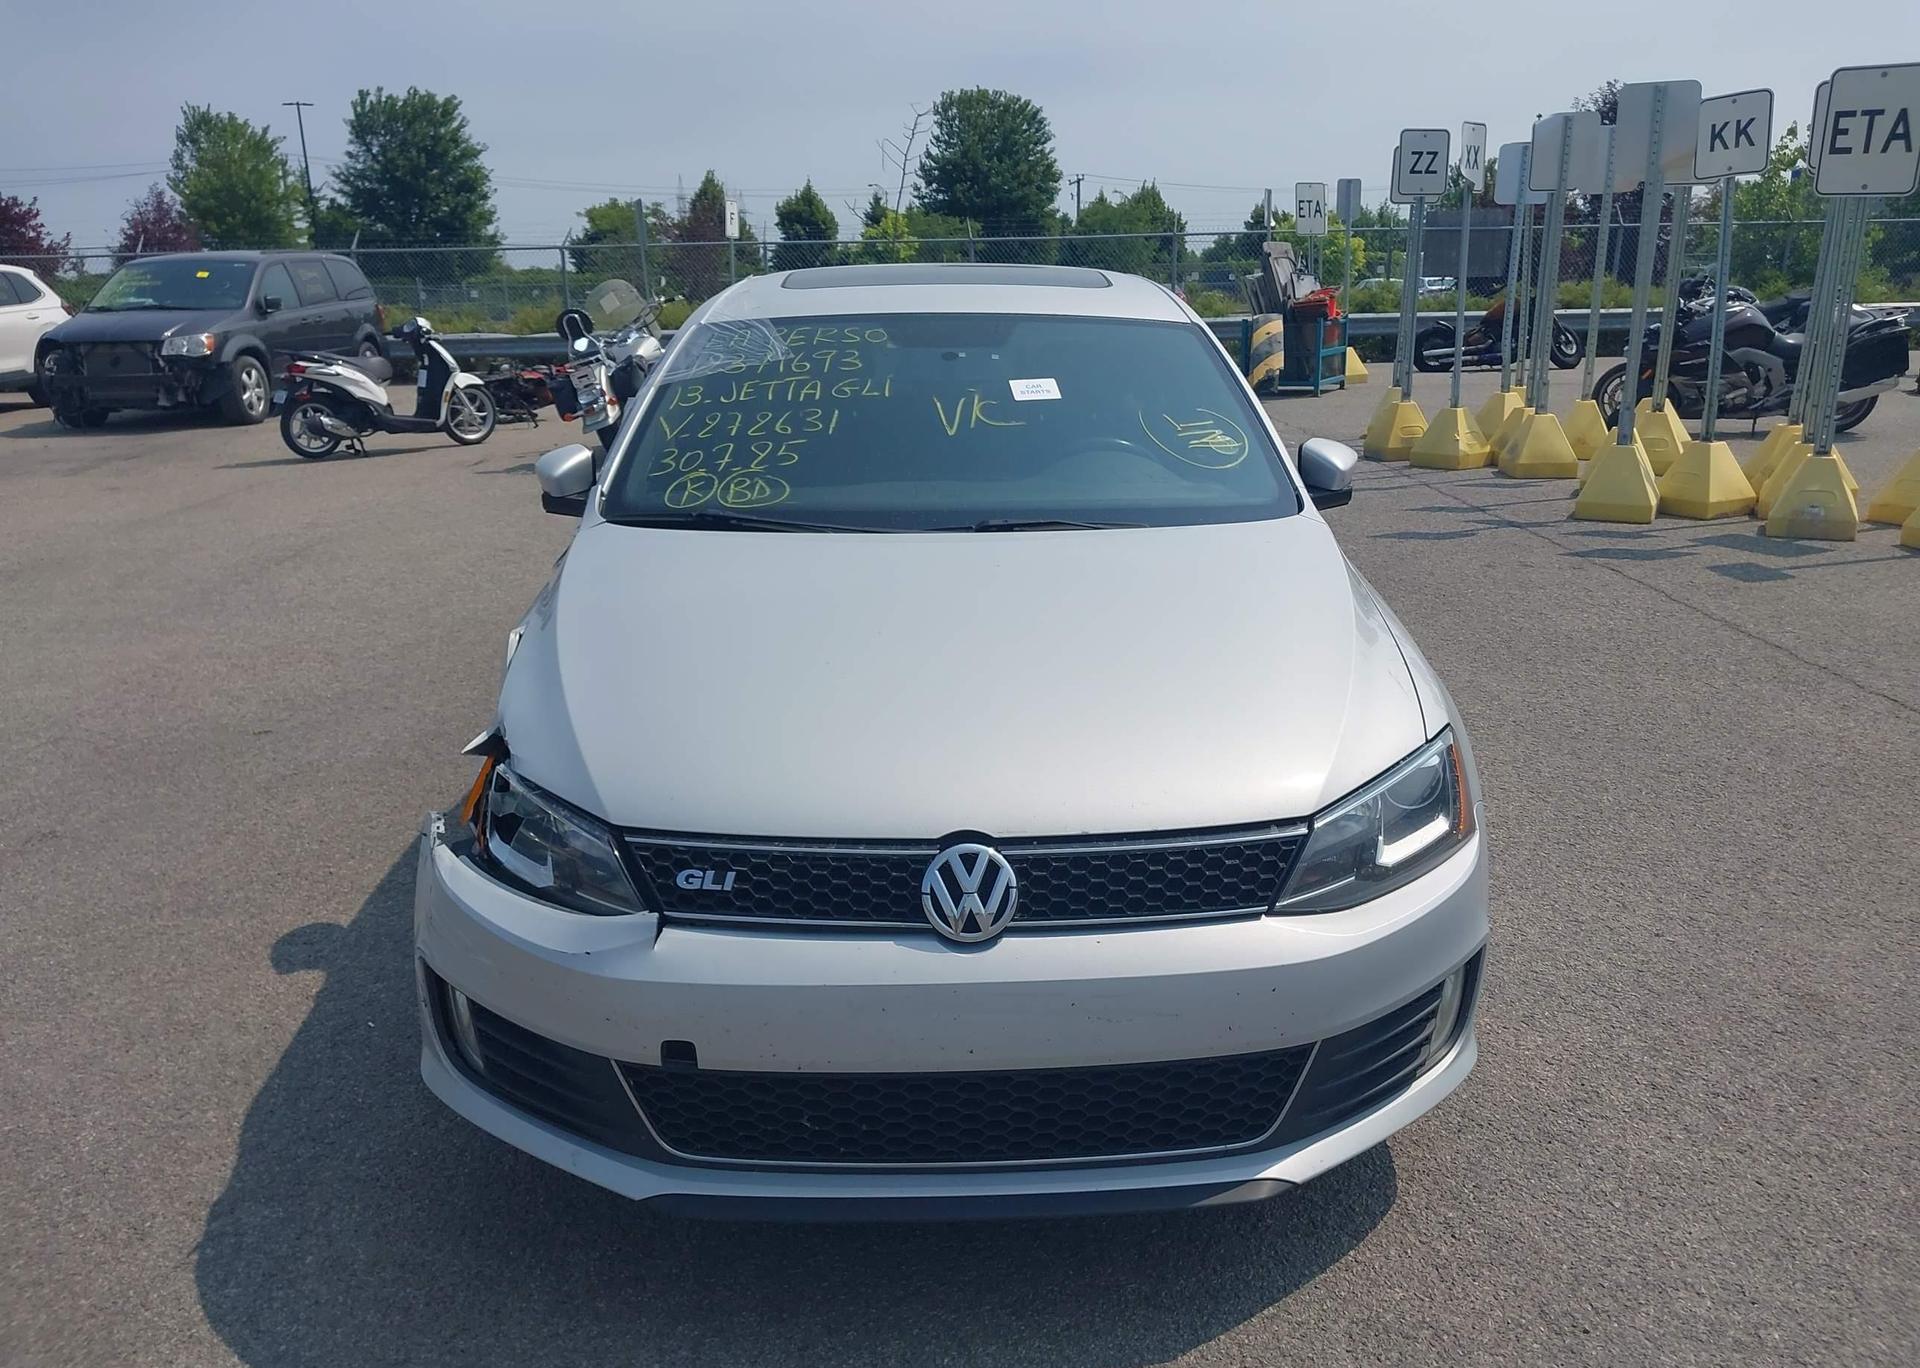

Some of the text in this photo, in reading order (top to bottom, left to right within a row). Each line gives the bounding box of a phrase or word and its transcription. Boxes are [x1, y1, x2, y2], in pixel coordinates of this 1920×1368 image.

[1709, 116, 1757, 153] KK
[1827, 107, 1913, 156] ETA
[1408, 150, 1439, 175] ZZ
[1464, 144, 1480, 171] XX
[1298, 199, 1323, 219] ETA
[831, 376, 893, 398] GLI
[675, 868, 737, 892] GLI
